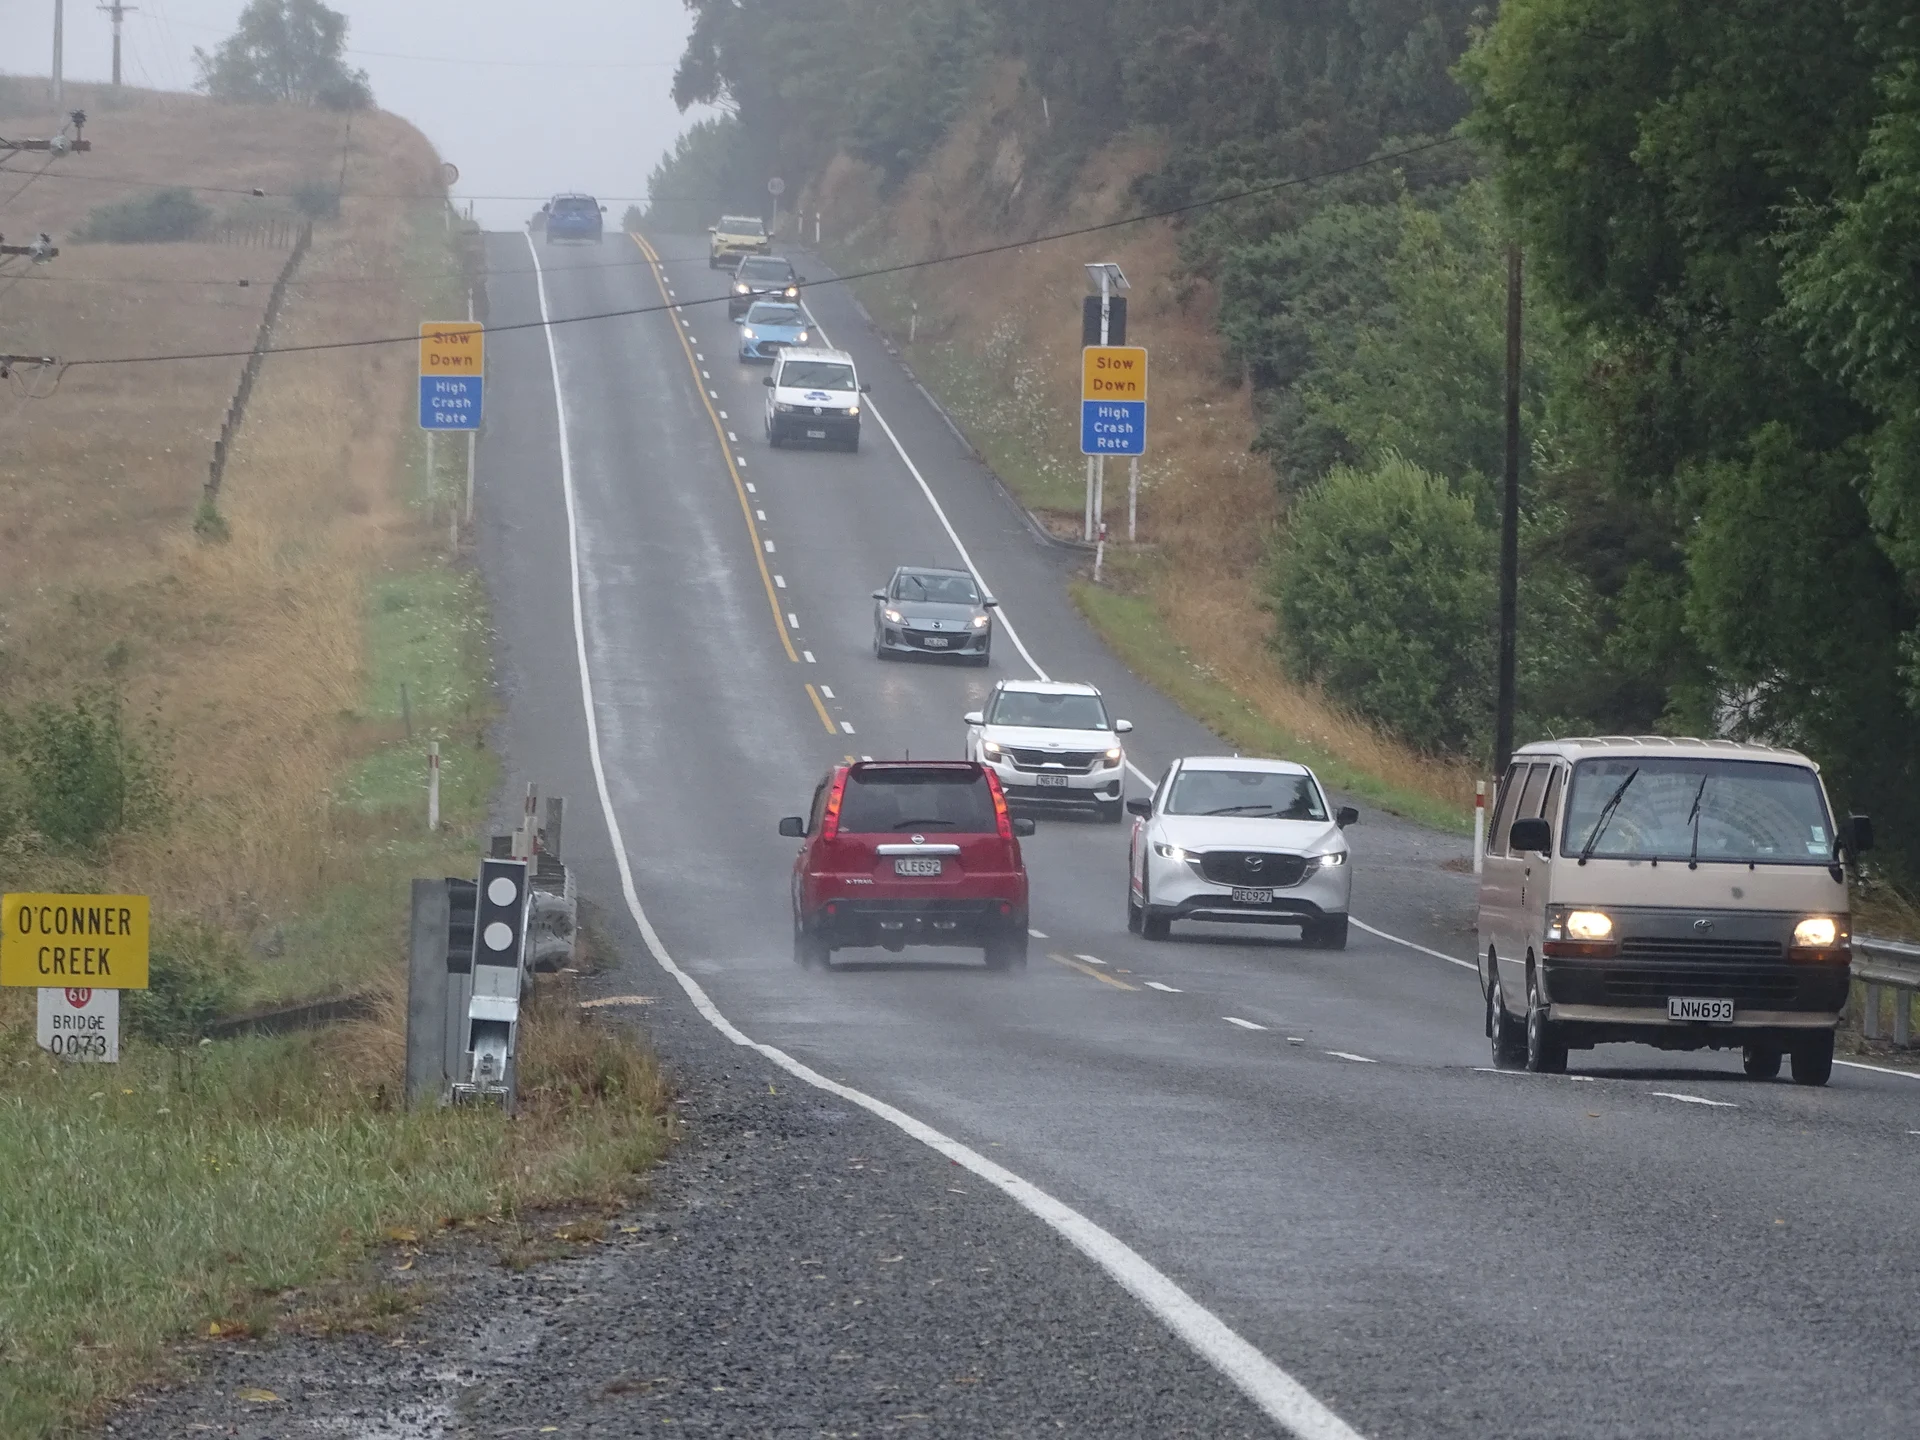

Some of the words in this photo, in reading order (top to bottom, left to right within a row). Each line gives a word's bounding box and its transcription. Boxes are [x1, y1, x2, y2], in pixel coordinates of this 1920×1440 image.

[430, 354, 473, 366] Down
[1096, 357, 1134, 370] Slow
[436, 382, 467, 395] High
[1093, 379, 1136, 391] Down
[431, 397, 472, 409] Crash
[435, 413, 468, 424] Rate
[1098, 407, 1130, 421] High
[1093, 422, 1134, 434] Crash
[1097, 437, 1130, 449] Rate
[896, 861, 941, 873] KLE692
[18, 906, 132, 936] O'CONNER
[37, 946, 112, 976] CREEK
[69, 988, 88, 1002] 60
[1670, 1001, 1732, 1019] LNW693
[52, 1015, 106, 1030] BRIDGE
[51, 1034, 107, 1056] 0073
